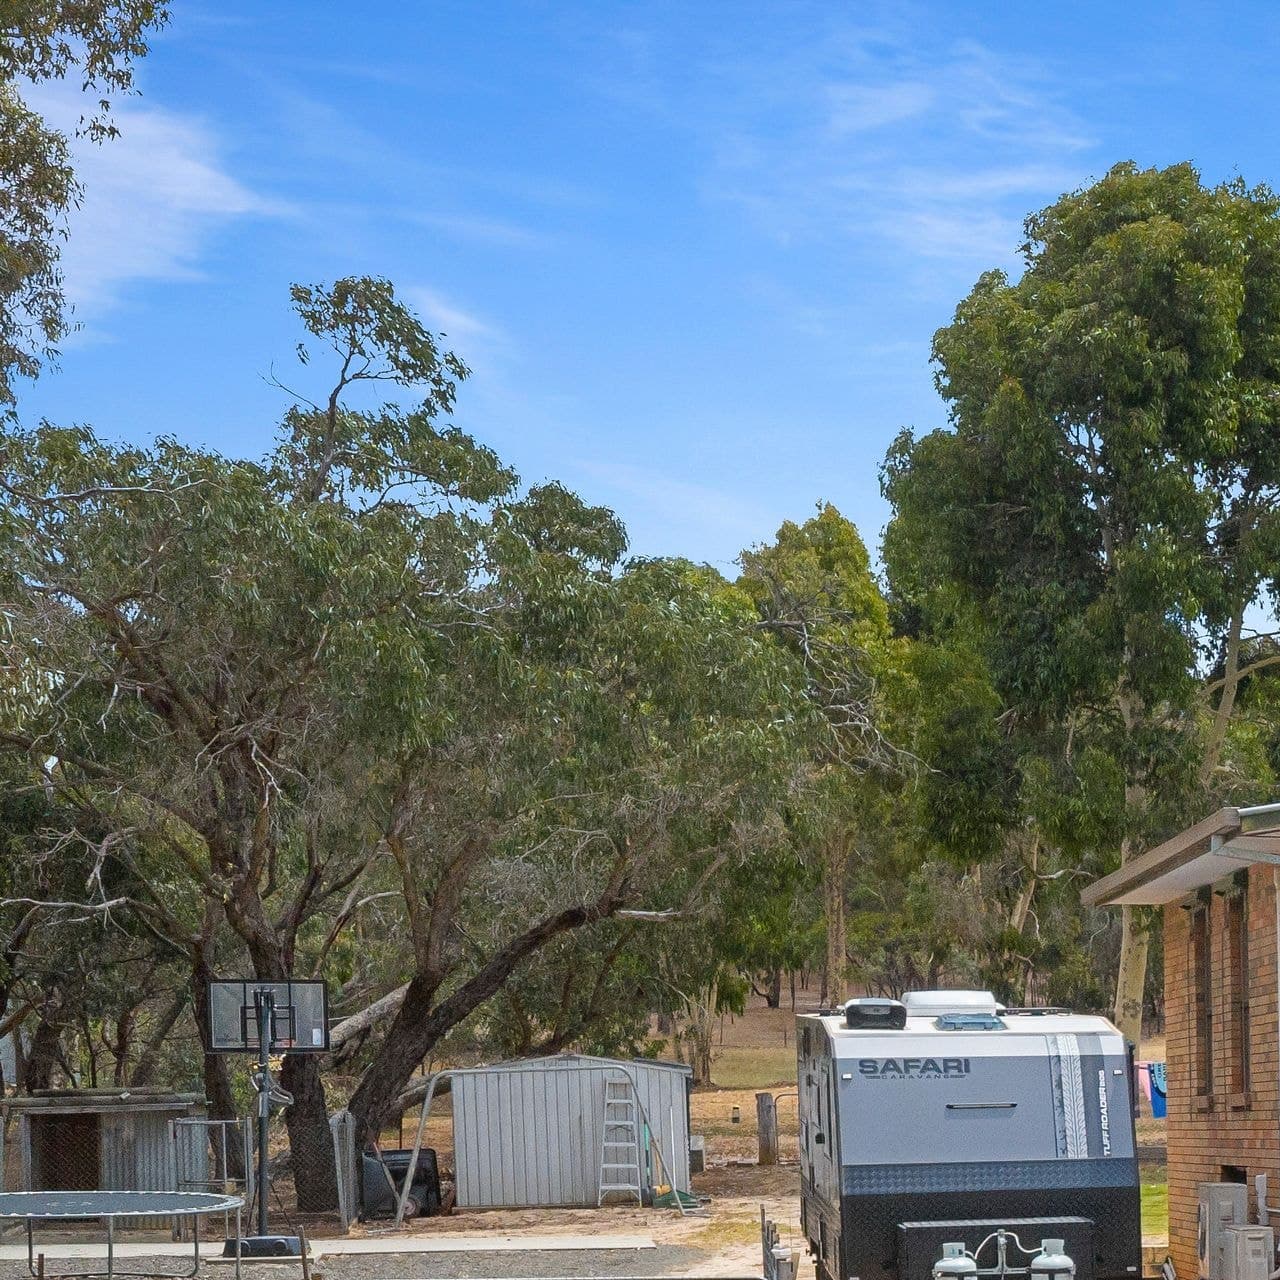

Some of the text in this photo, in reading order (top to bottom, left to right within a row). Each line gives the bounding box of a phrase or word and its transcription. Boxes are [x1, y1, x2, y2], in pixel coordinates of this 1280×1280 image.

[858, 1058, 971, 1074] SAFARI
[1099, 1087, 1109, 1130] ROADER
[1103, 1131, 1111, 1156] TUFF
